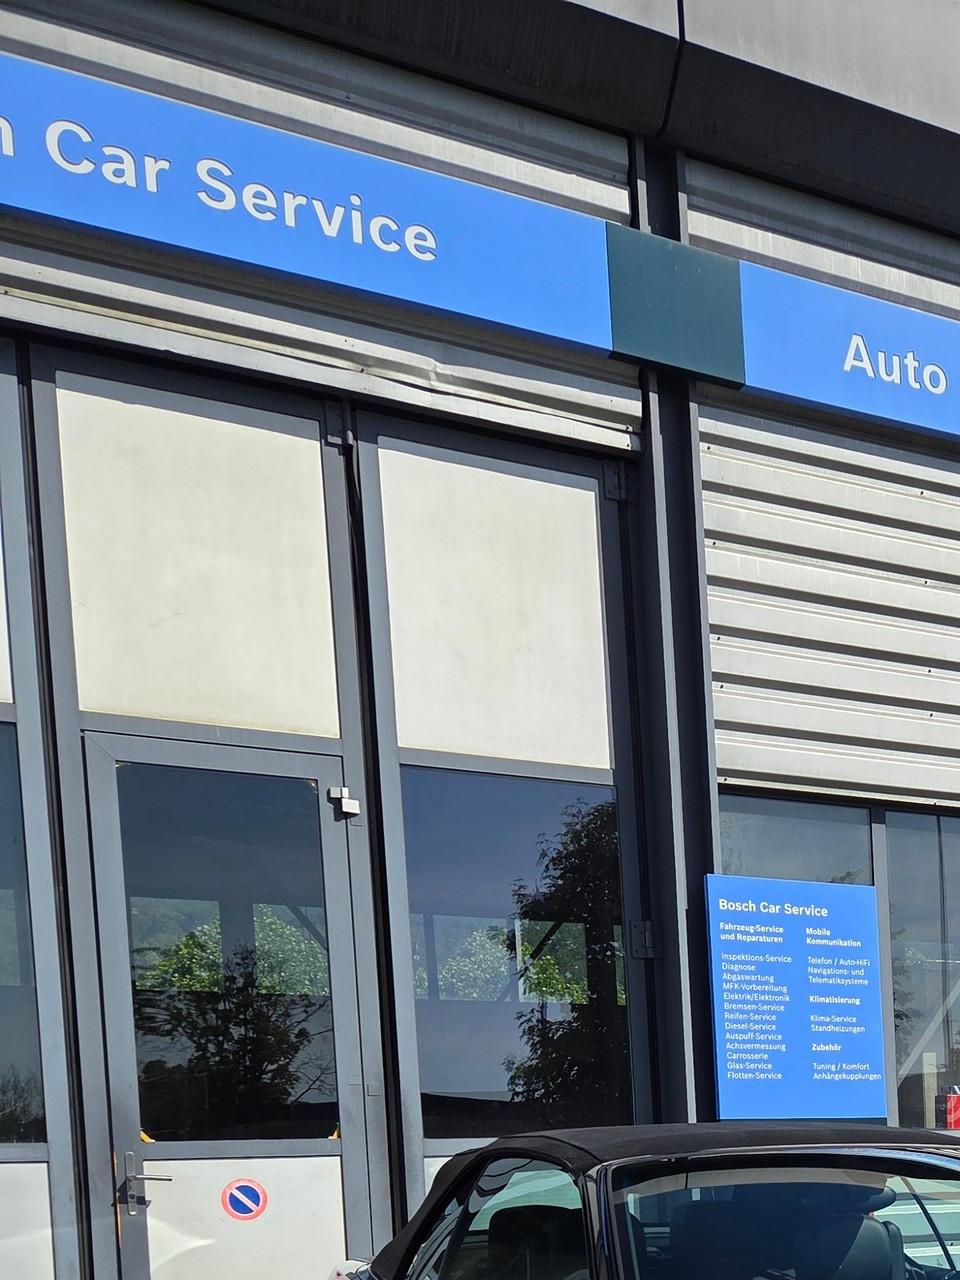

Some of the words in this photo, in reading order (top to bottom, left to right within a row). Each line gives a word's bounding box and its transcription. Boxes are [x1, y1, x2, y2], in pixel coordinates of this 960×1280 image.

[45, 118, 171, 193] Car
[196, 157, 438, 261] Service
[843, 333, 948, 395] Auto
[719, 898, 756, 912] Bosch
[760, 901, 781, 914] Car
[784, 903, 828, 917] Service
[720, 922, 784, 933] Fahrzeug-Service
[805, 927, 831, 936] Mobile
[737, 933, 783, 943] Reparaturen
[806, 937, 861, 947] Kommunikation
[721, 952, 792, 963] Inspektions-Service
[808, 956, 833, 965] Telefon
[722, 962, 756, 972] Diagnose
[851, 968, 864, 976] und
[722, 972, 774, 983] Abgaswartung
[808, 975, 869, 986] Telematiksysteme
[723, 982, 787, 994] MFK-Vorbereitung
[723, 992, 791, 1002] Elektrik/Elektronik
[809, 995, 861, 1005] Klimatisierung
[724, 1002, 785, 1012] Bremsen-Service
[724, 1012, 777, 1021] Reifen-Service
[810, 1014, 857, 1023] Klima-Service
[725, 1022, 777, 1031] Diesel-Service
[810, 1024, 865, 1034] Standheizungen
[725, 1032, 783, 1041] Auspuff-Service
[726, 1042, 786, 1052] Achsvermessung
[811, 1043, 842, 1051] Zubehör
[726, 1051, 769, 1060] Carrosserie
[727, 1061, 773, 1070] Glas-Service
[812, 1062, 836, 1071] Tuning
[727, 1071, 783, 1080] Flotten-Service
